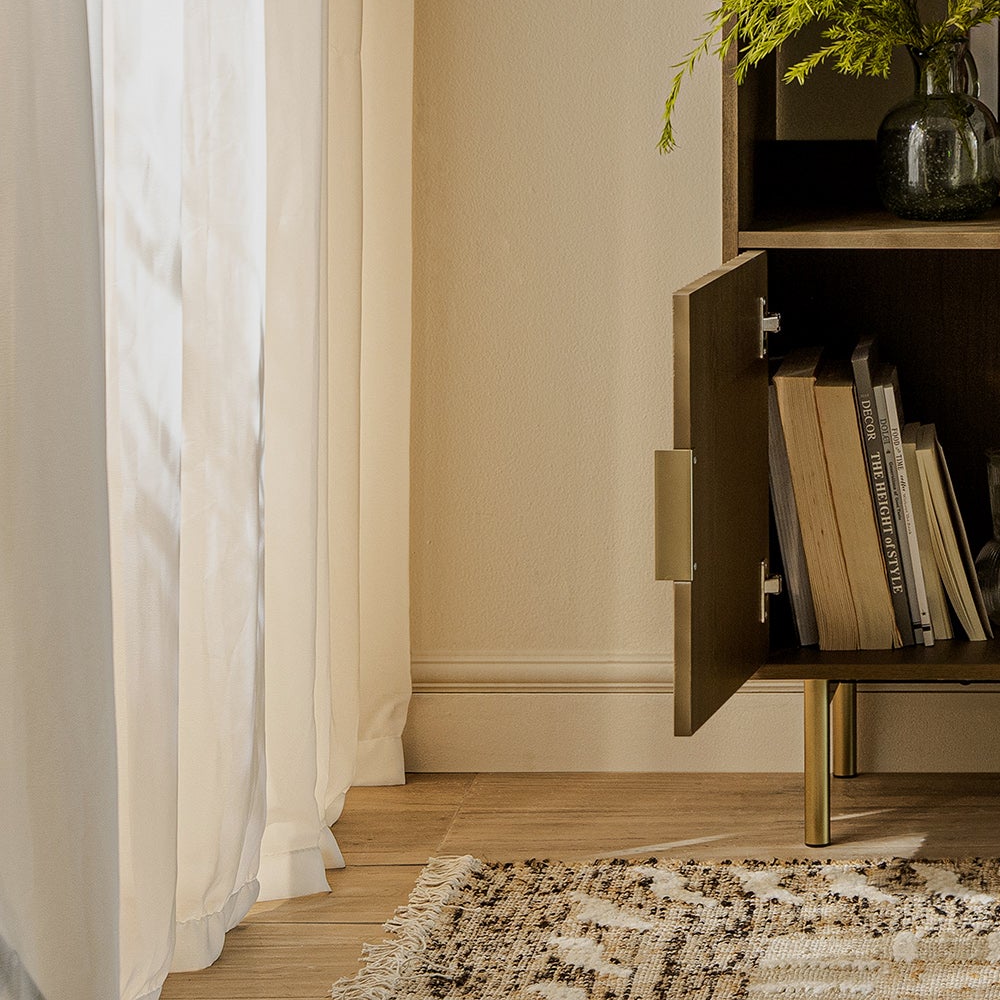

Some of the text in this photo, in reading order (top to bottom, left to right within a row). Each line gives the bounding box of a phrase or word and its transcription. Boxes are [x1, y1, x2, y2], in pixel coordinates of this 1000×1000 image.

[861, 399, 877, 441] DECOR
[891, 427, 900, 446] FOOD
[870, 451, 884, 480] THE
[895, 454, 904, 470] TIME
[875, 482, 894, 535] HEIGHT
[884, 537, 896, 549] of
[887, 550, 903, 594] STYLE
